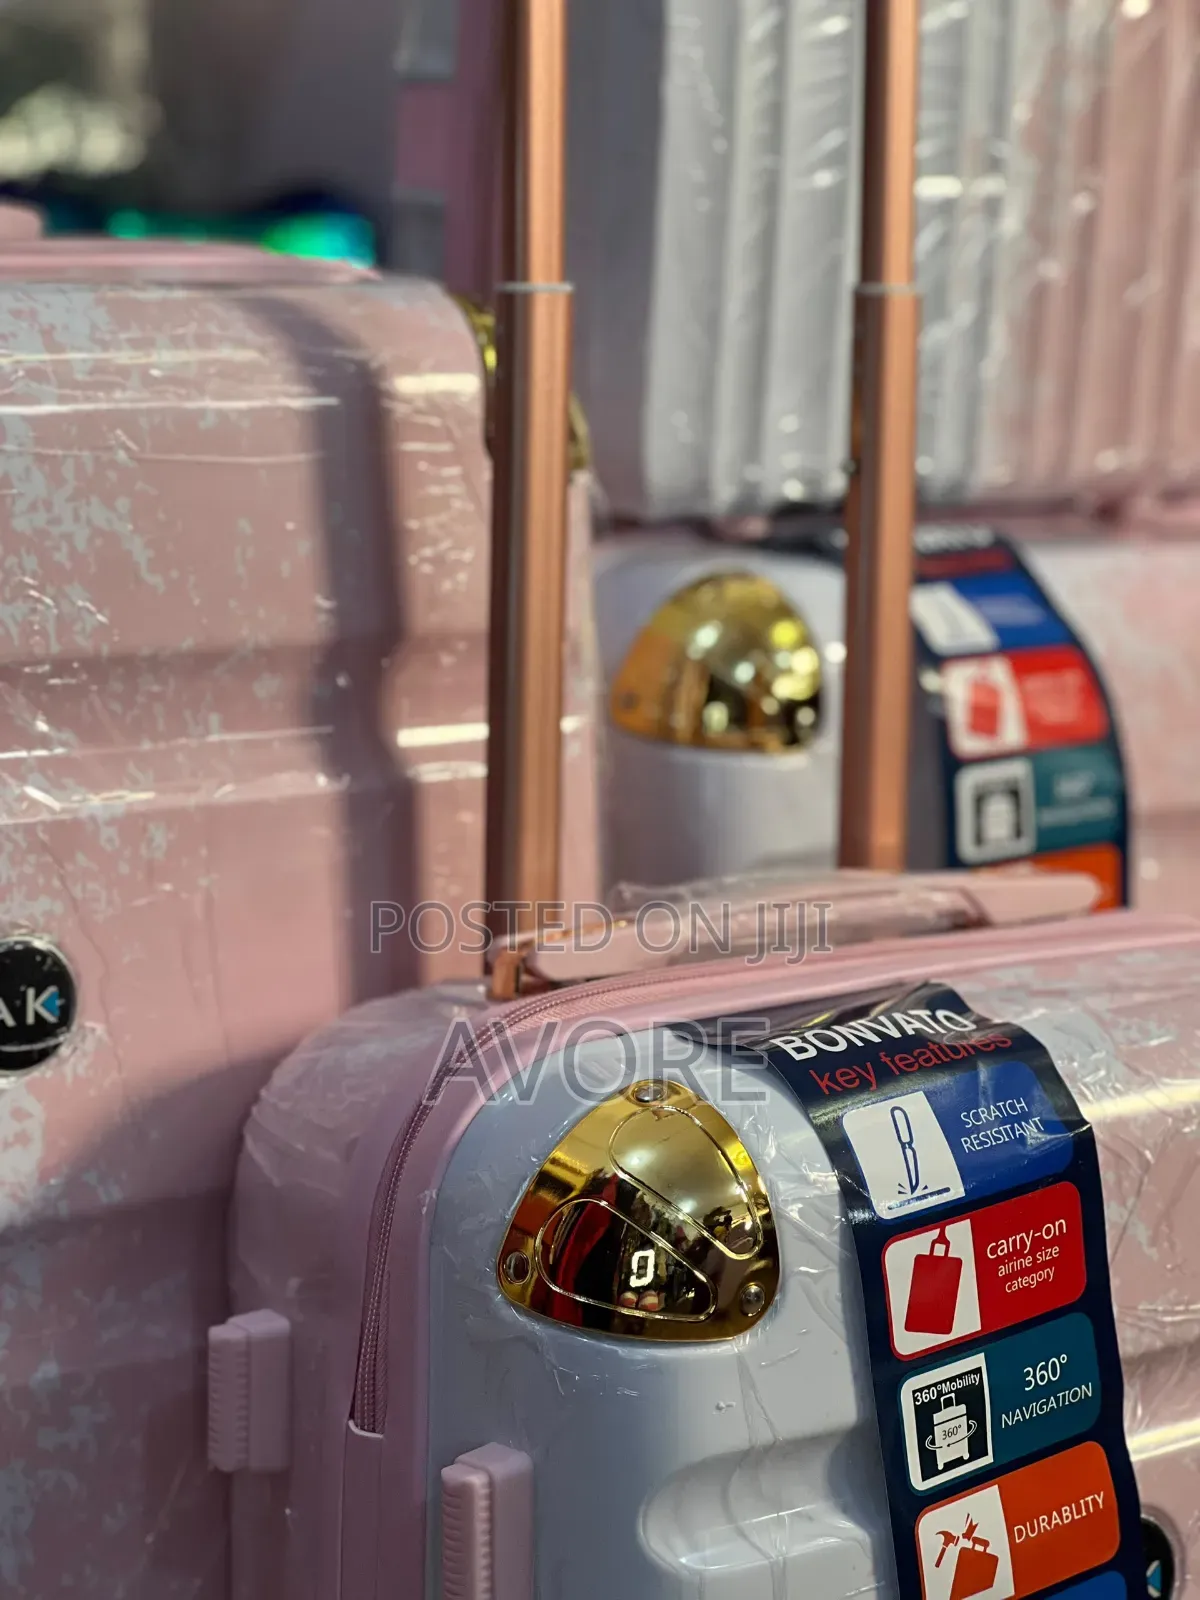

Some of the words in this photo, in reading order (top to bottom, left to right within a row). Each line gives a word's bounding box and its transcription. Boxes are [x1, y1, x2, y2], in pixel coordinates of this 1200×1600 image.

[769, 1009, 977, 1061] BONVATO
[809, 1061, 877, 1095] key
[880, 1033, 1012, 1076] features
[960, 1097, 1028, 1128] SCRATCH
[986, 1219, 1067, 1259] carry-on
[998, 1255, 1033, 1277] airine
[1036, 1245, 1060, 1264] size
[1005, 1266, 1055, 1293] category
[1023, 1353, 1068, 1391] 360°
[1001, 1382, 1093, 1429] NAVIGATION
[1013, 1491, 1104, 1543] DURABLITY
